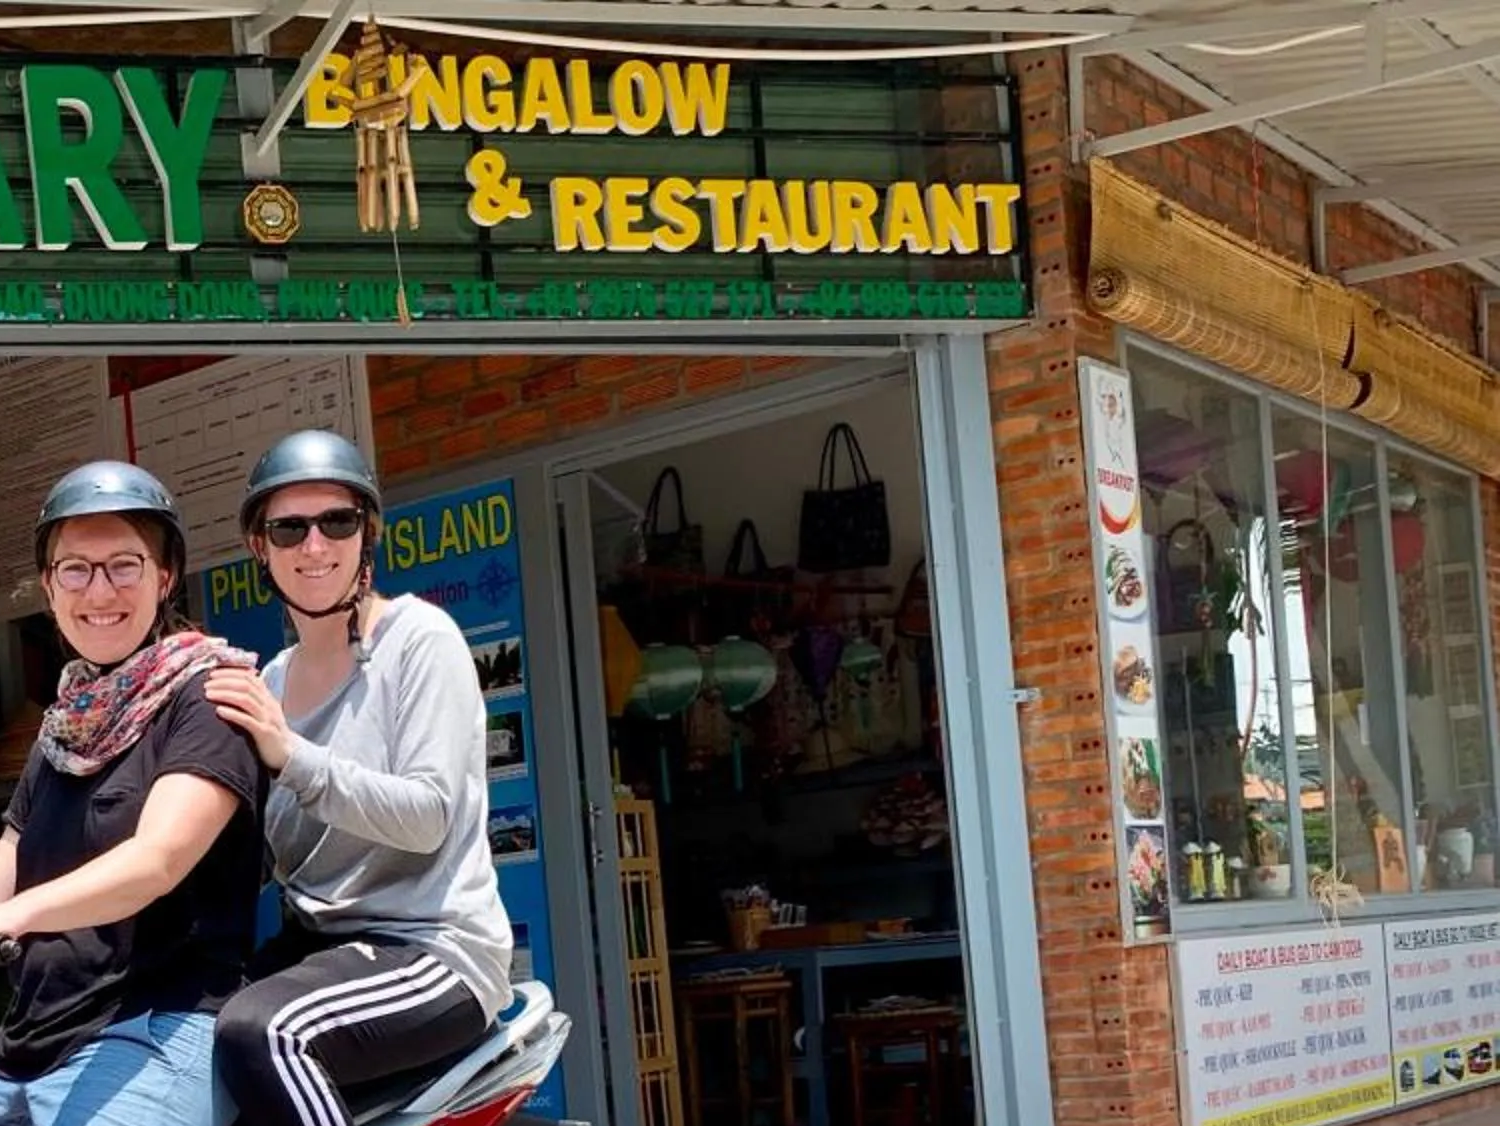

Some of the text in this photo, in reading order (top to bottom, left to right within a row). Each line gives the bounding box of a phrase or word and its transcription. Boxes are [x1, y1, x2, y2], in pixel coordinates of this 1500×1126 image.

[465, 149, 1021, 255] & RESTAURANT
[384, 494, 512, 573] ISLAND
